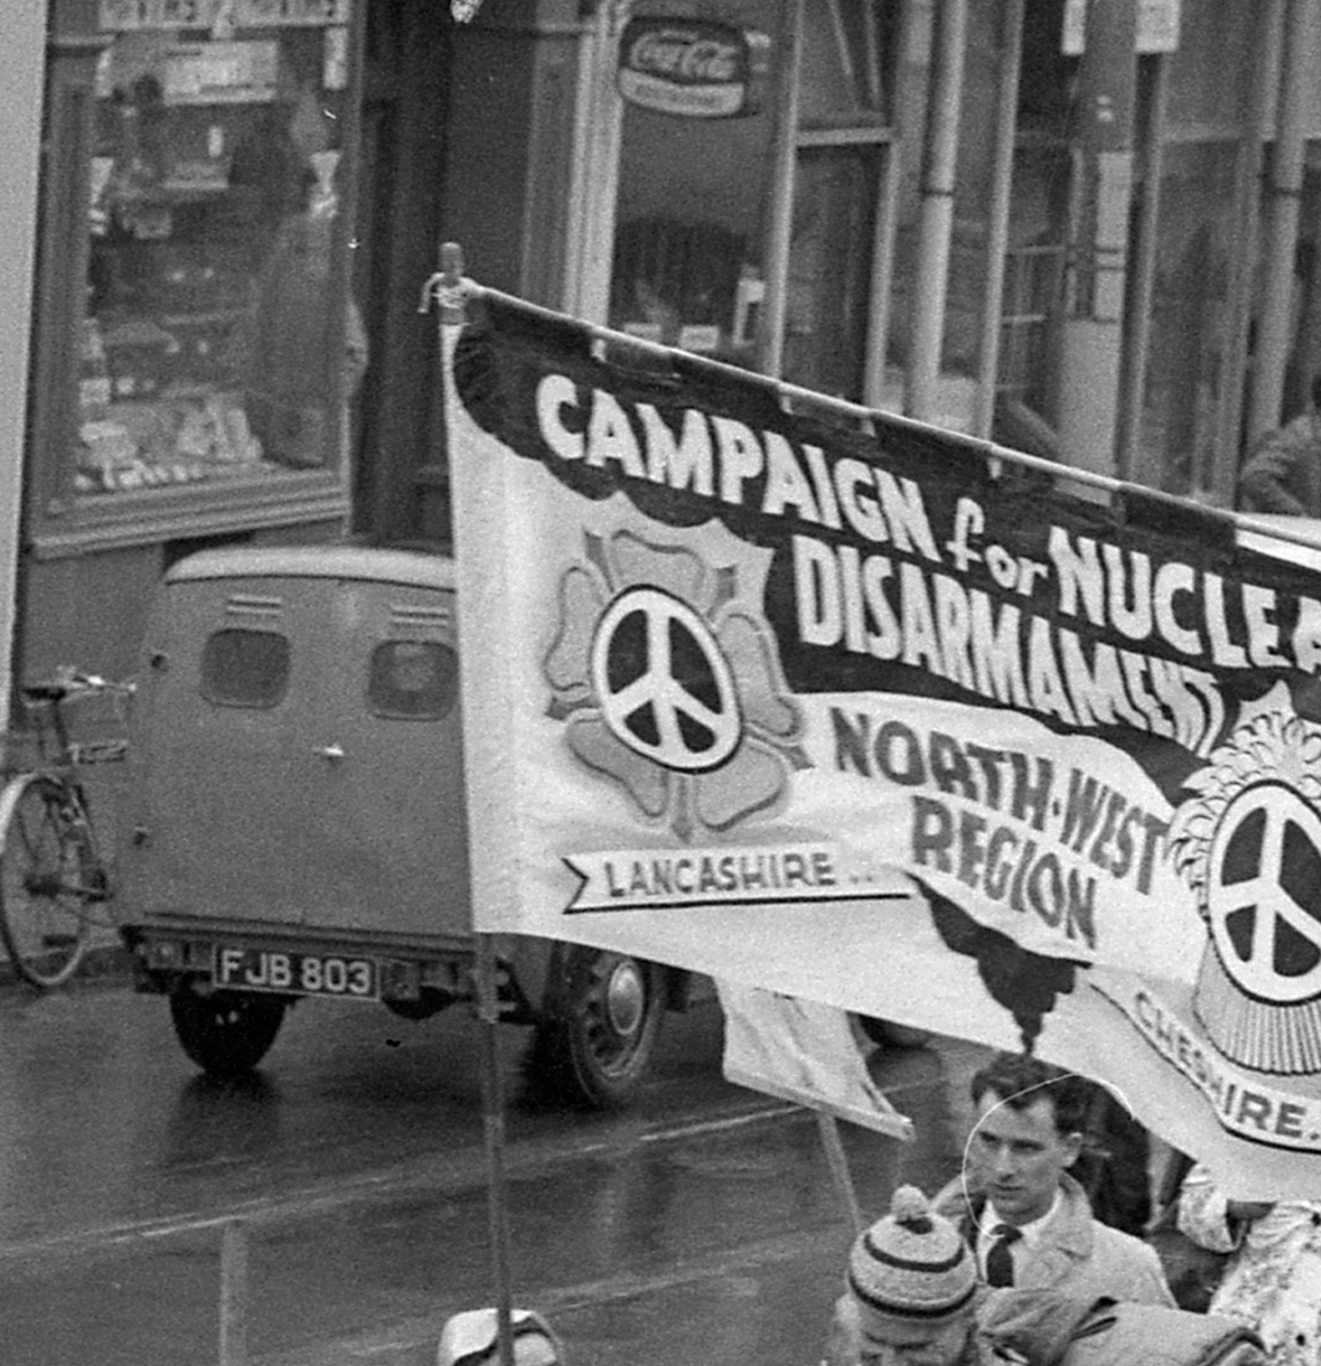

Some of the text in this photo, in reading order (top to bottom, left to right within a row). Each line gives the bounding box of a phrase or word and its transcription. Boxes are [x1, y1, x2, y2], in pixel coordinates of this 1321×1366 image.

[630, 28, 740, 80] Coca-Cola
[537, 373, 942, 562] CAMPAIGN
[946, 497, 1047, 598] for
[791, 534, 1226, 757] DISARMAMENT
[911, 793, 1097, 949] REGION
[219, 948, 373, 993] FJB 803
